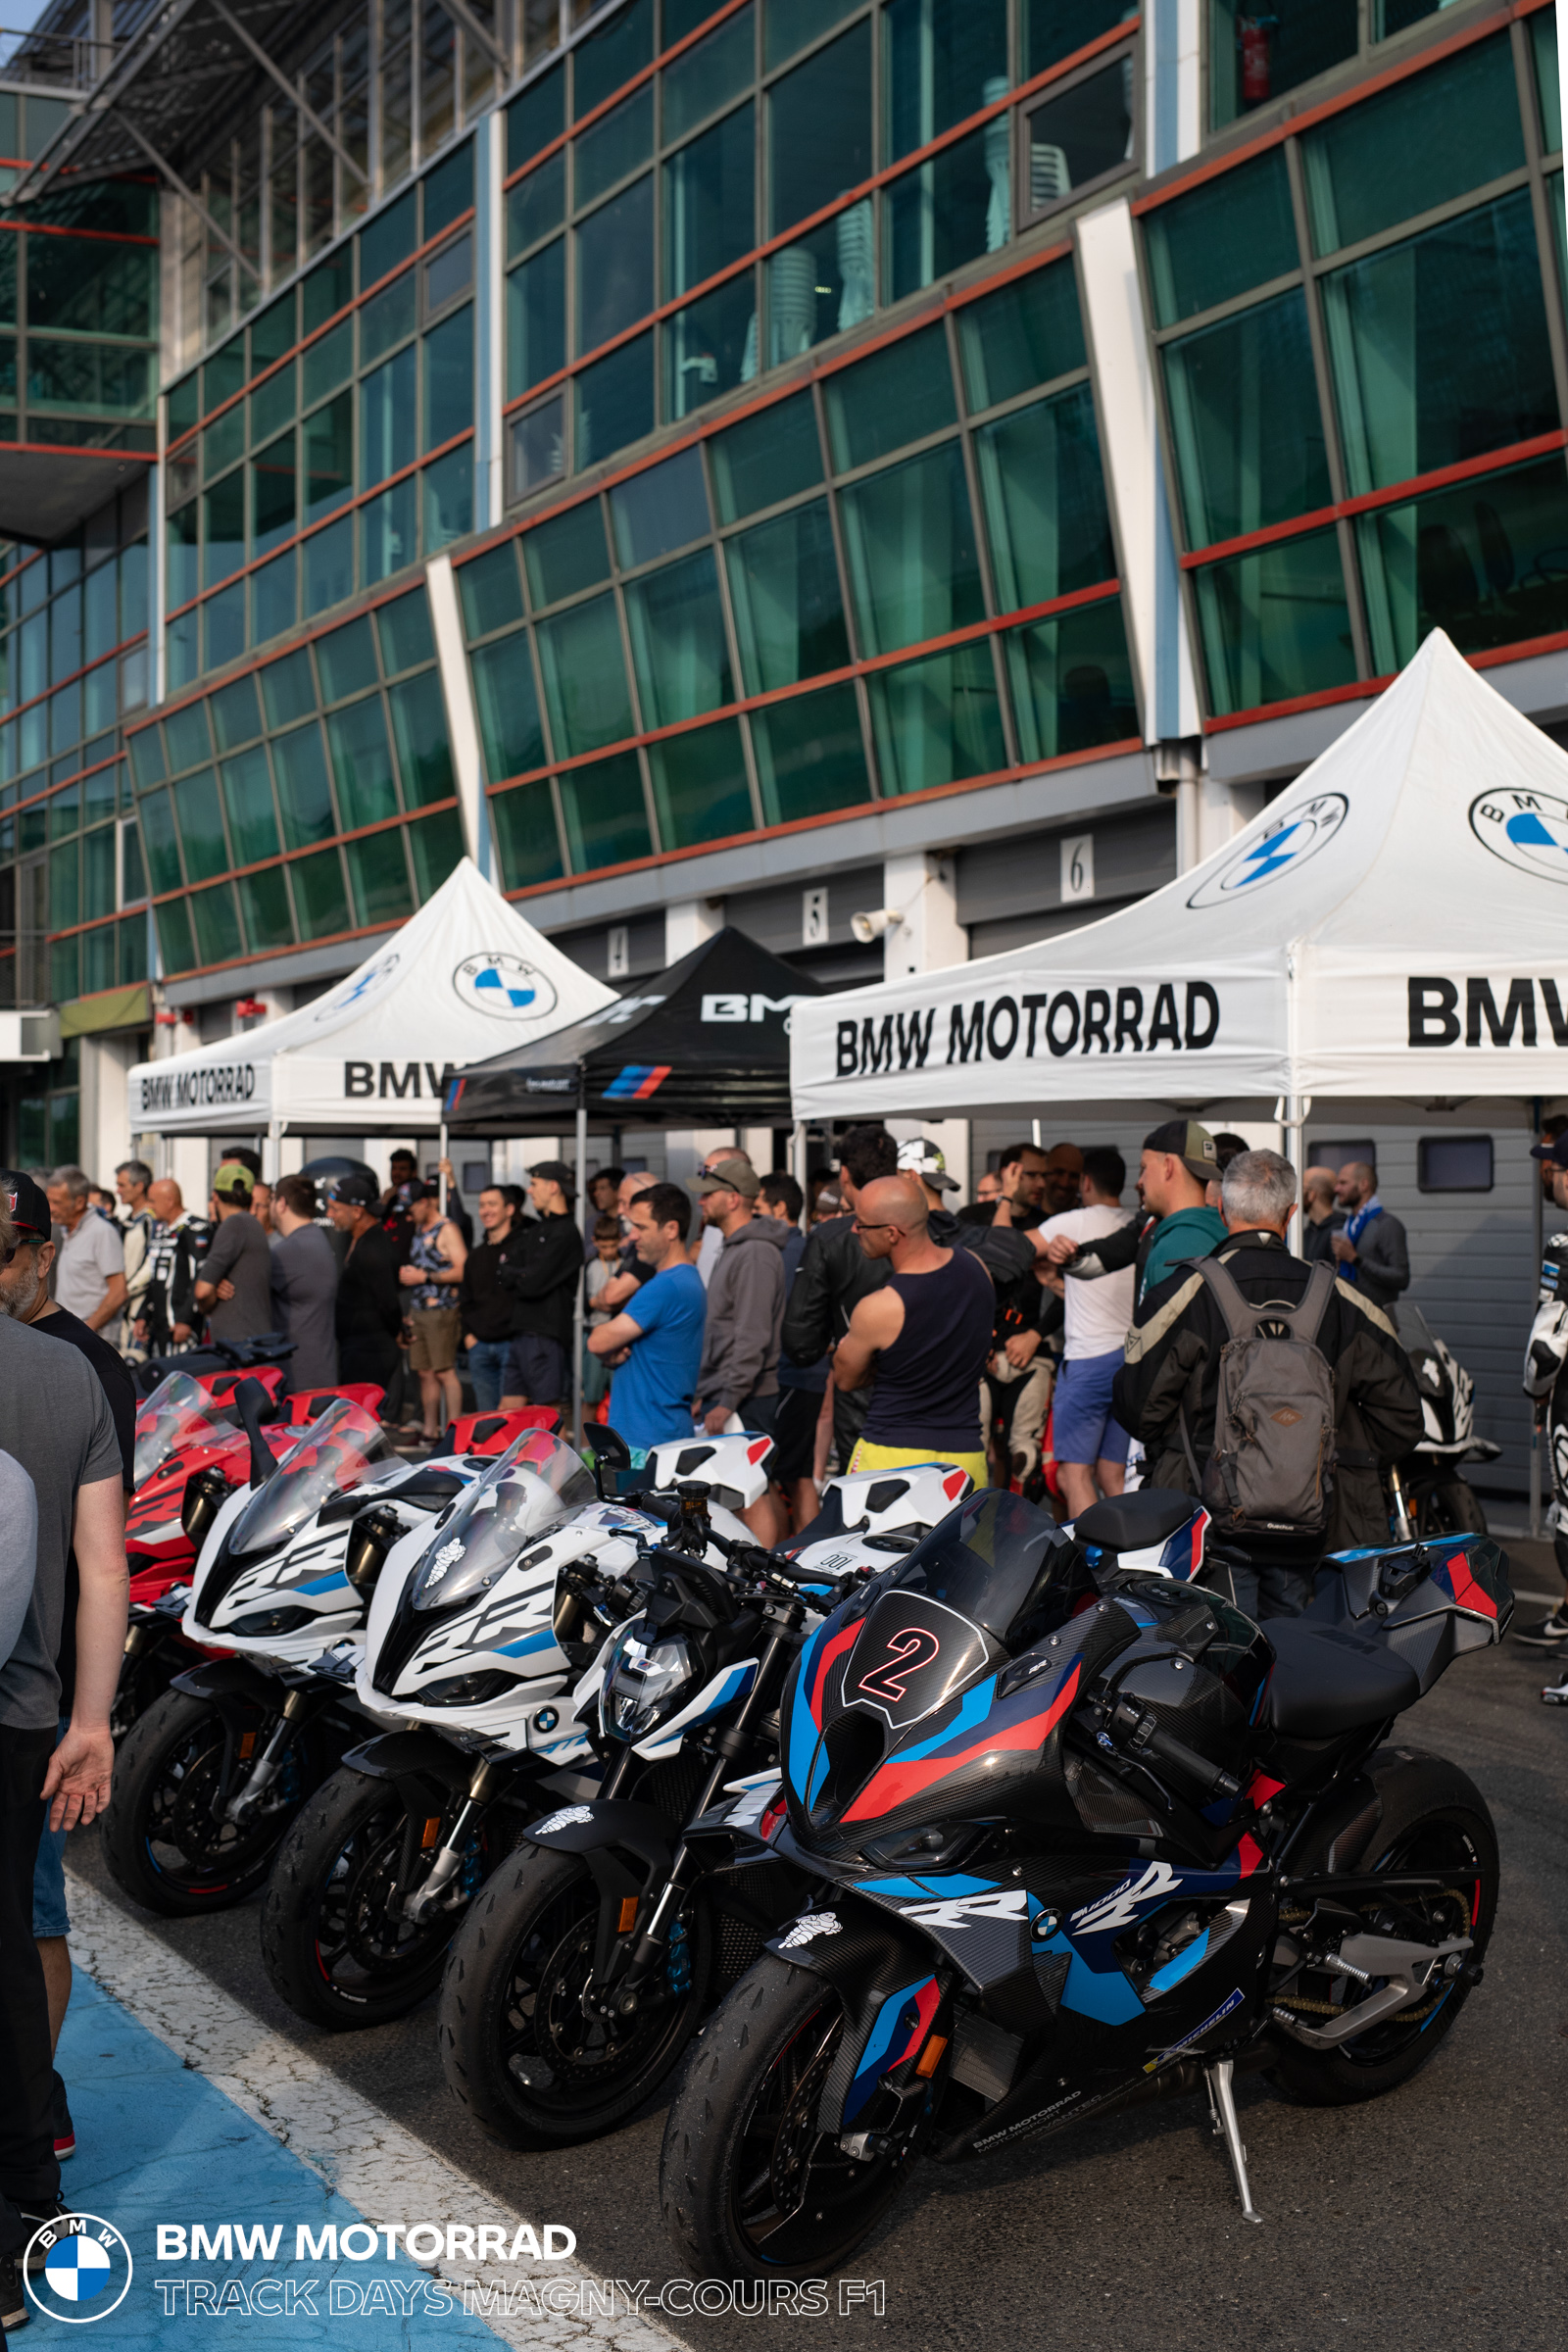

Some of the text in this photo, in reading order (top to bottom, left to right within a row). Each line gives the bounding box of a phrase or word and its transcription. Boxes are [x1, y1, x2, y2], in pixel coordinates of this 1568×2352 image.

[1479, 793, 1568, 823] BM
[1070, 843, 1084, 893] 6
[808, 894, 820, 938] 5
[836, 981, 1219, 1077] BMW MOTORRAD
[140, 1064, 256, 1111] BMW MOTORRAD
[858, 1627, 940, 1703] 2
[898, 1889, 1029, 1930] RR
[1070, 1860, 1184, 1936] RR
[1175, 1999, 1235, 2051] MICHELIN
[972, 2129, 1007, 2150] BMW
[1007, 2089, 1082, 2133] MOTORRAD
[977, 2108, 1061, 2154] MOTORSPORT
[1021, 2093, 1102, 2141] ADVANTEC
